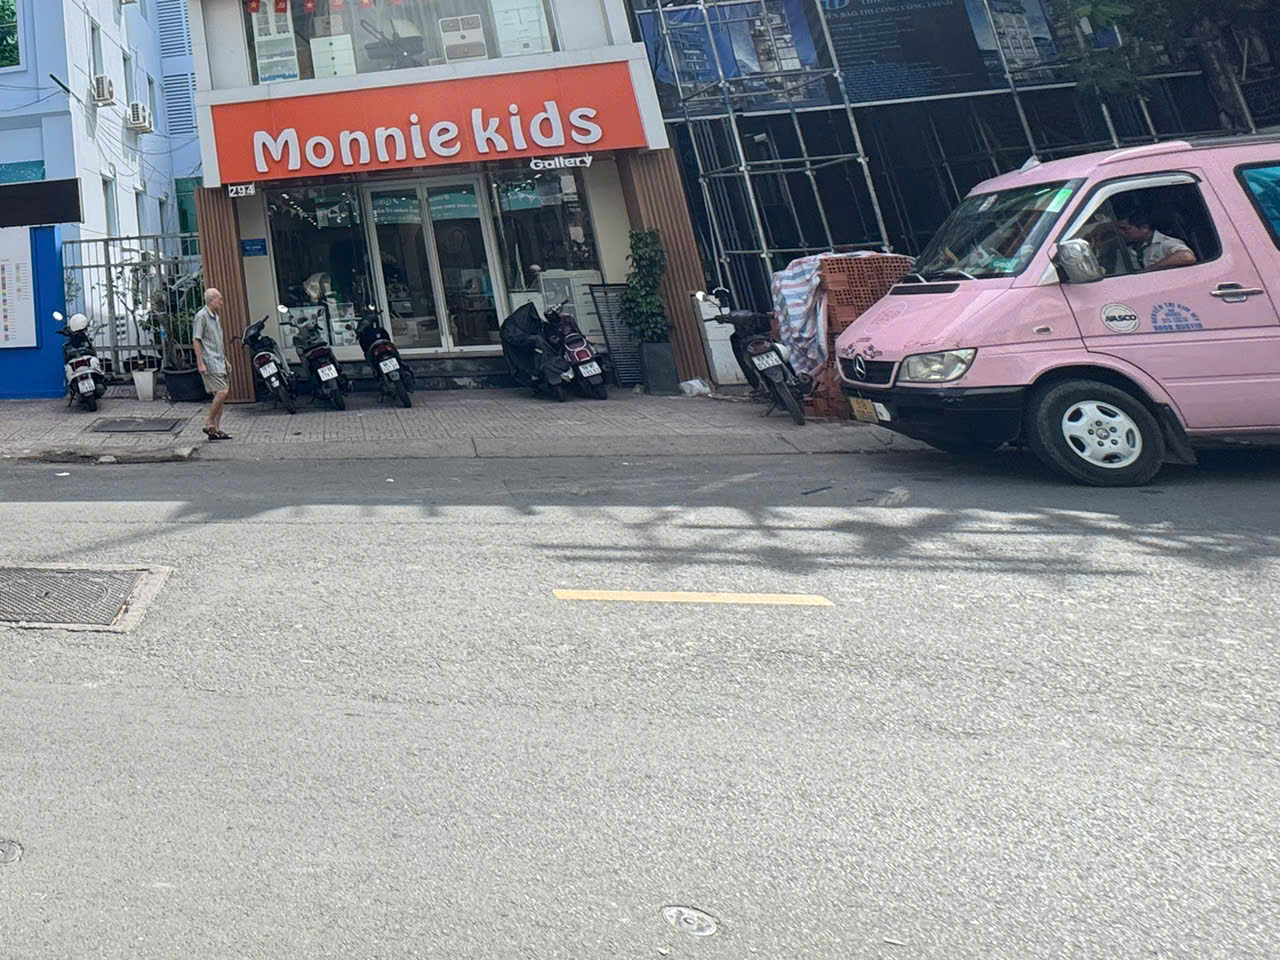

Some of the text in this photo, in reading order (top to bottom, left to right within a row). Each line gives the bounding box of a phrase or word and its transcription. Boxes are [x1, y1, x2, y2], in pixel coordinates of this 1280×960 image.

[252, 100, 603, 174] Monnie kids
[529, 154, 594, 172] Gallery
[228, 184, 255, 197] 294
